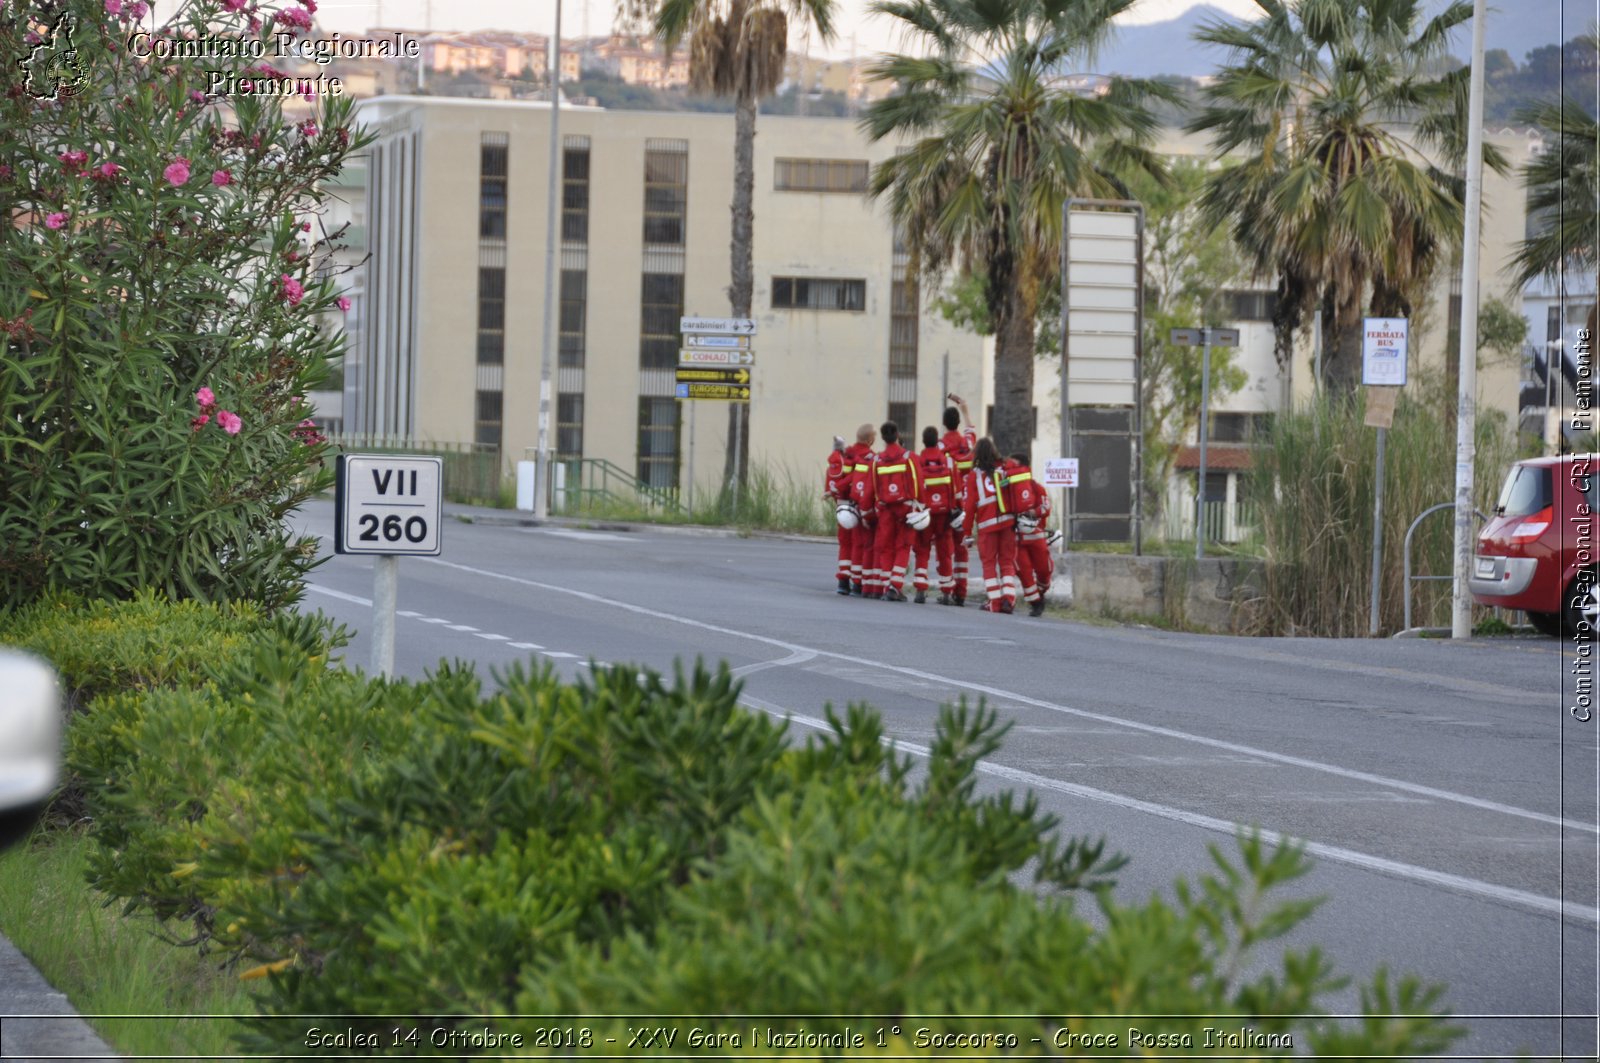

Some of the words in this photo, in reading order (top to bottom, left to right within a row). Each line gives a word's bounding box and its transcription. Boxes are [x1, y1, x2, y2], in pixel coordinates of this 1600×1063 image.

[682, 321, 726, 330] carabinieri
[1367, 331, 1405, 339] FERMATA
[1377, 339, 1394, 347] BUS
[692, 353, 727, 361] CONAD
[688, 384, 729, 393] EUROSPIN
[371, 468, 417, 496] VII
[358, 513, 428, 544] 260
